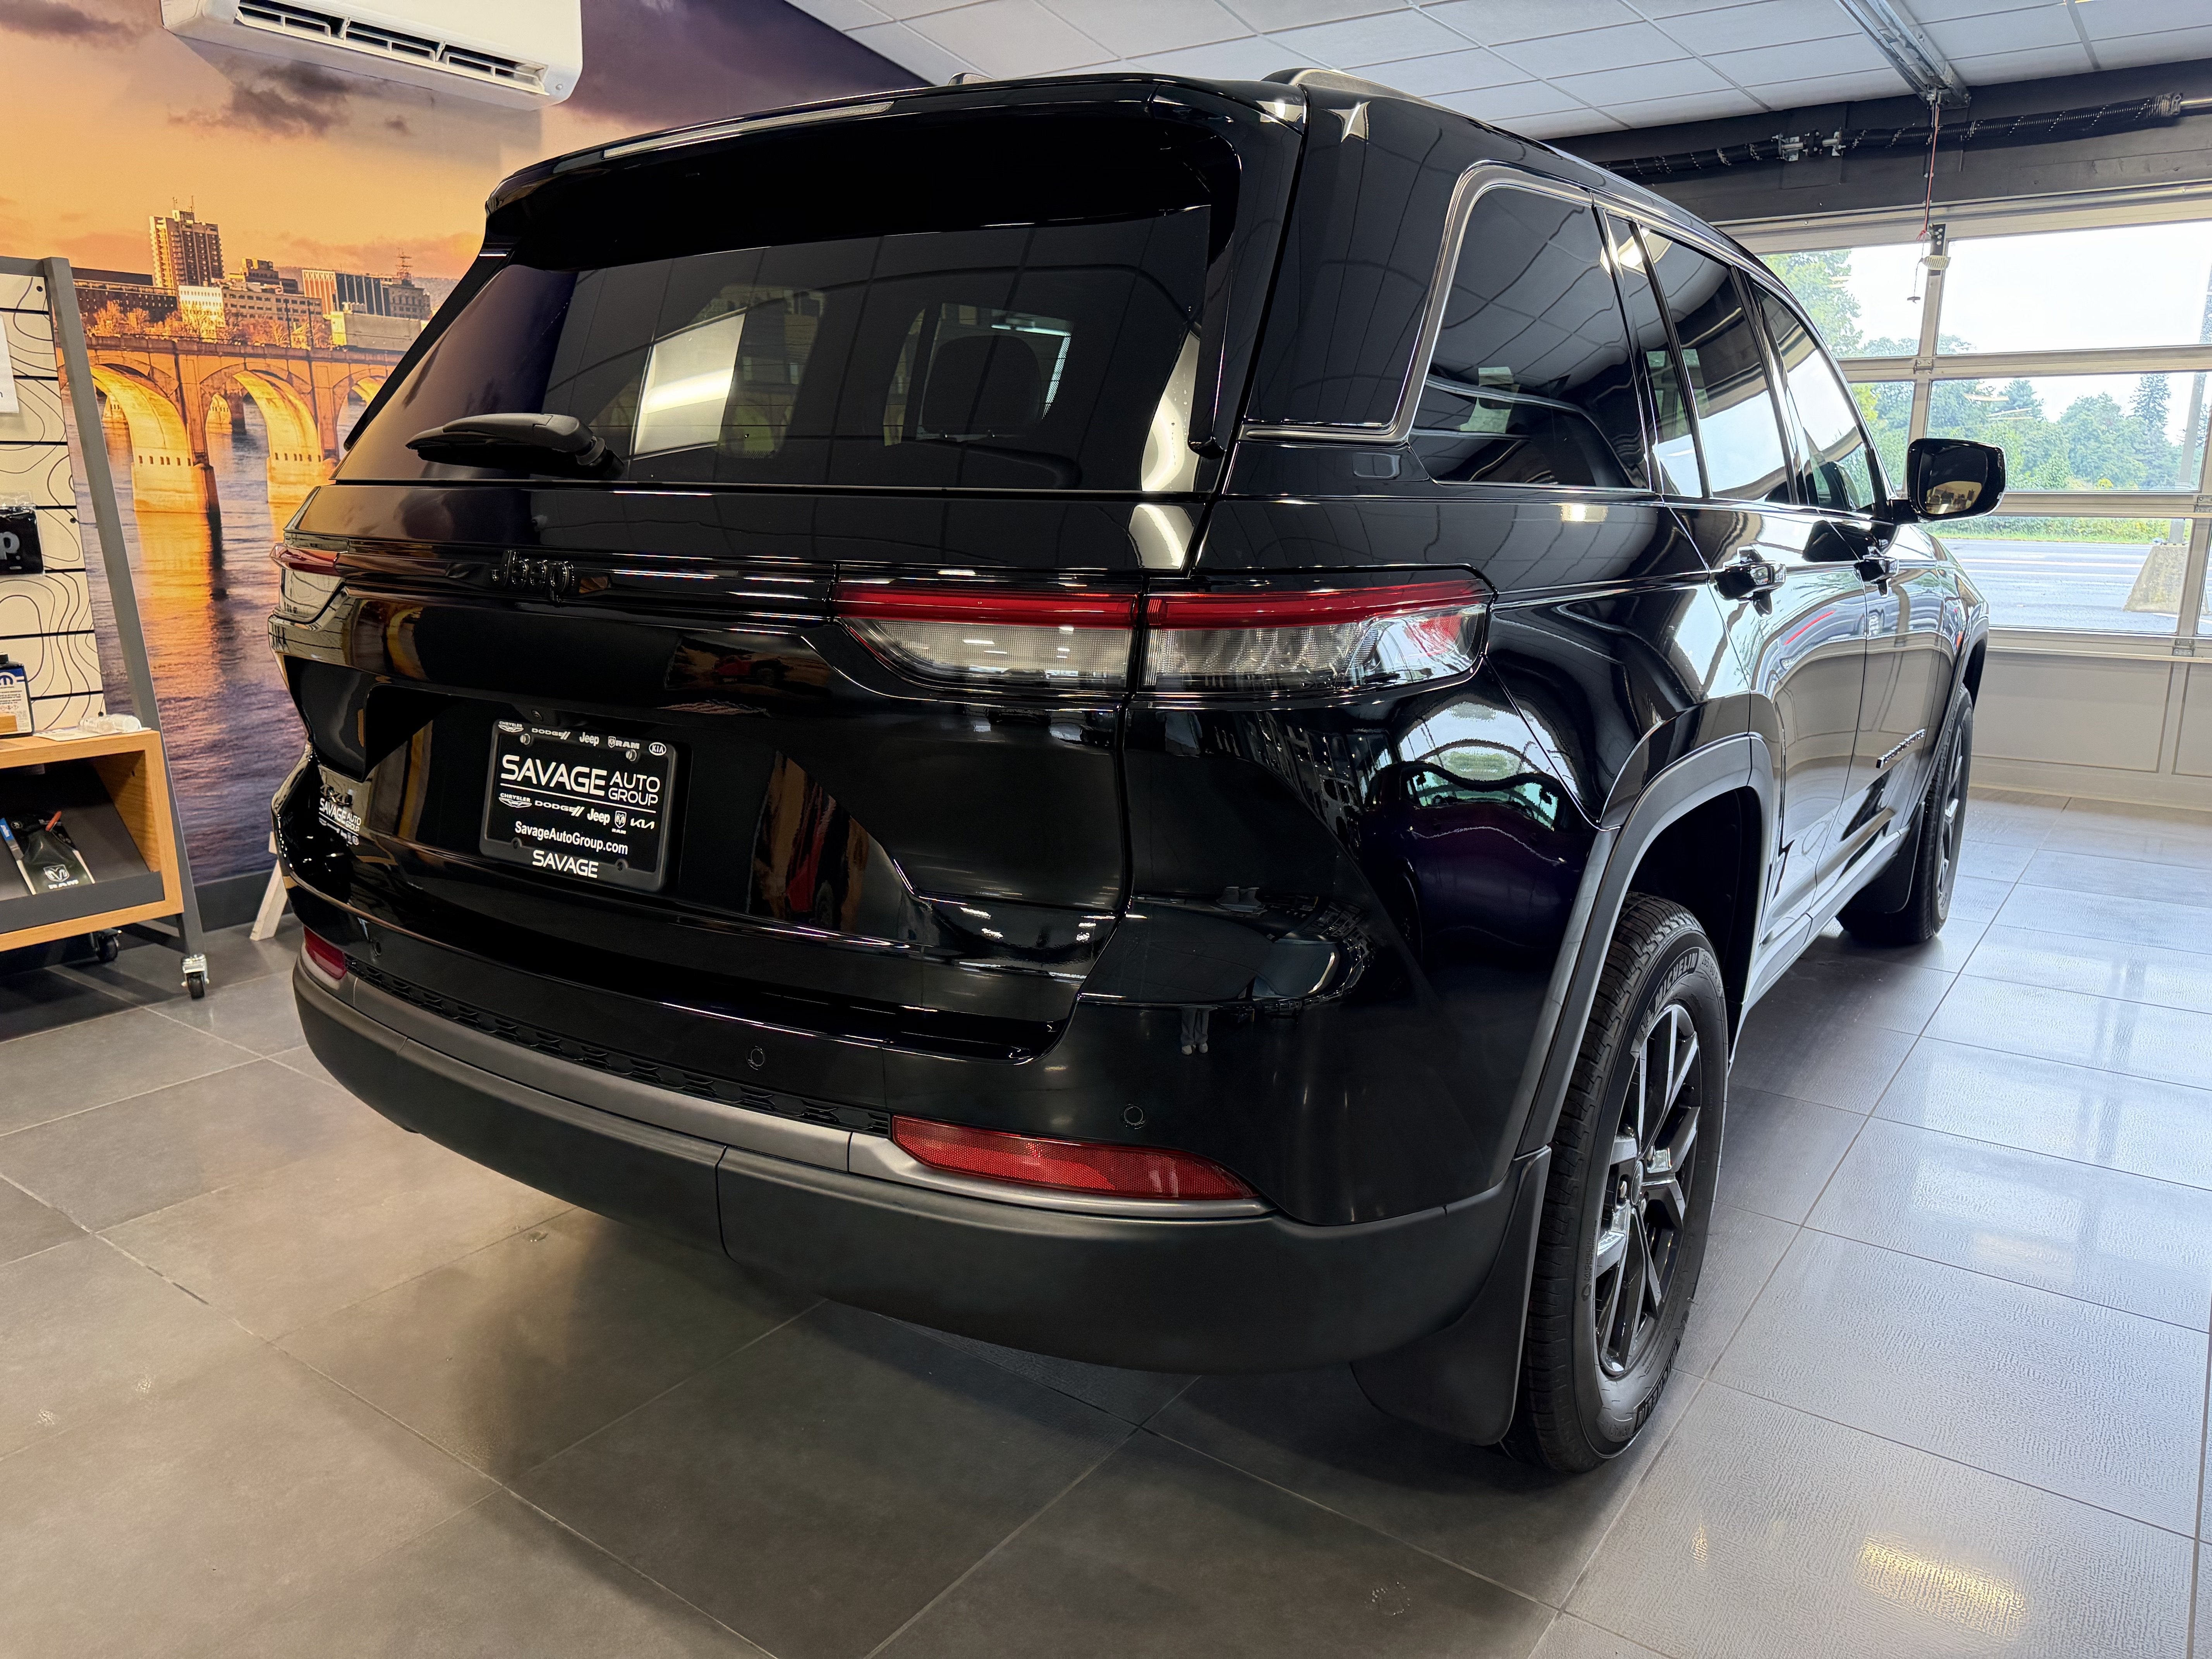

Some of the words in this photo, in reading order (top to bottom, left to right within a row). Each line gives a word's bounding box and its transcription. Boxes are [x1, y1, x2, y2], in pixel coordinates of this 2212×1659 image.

[491, 550, 574, 603] Jeep
[531, 728, 564, 737] DODGE
[579, 732, 599, 746] Jeep
[615, 740, 640, 749] RAM
[501, 754, 607, 796] SAVAGE
[610, 771, 661, 793] AUTO
[500, 793, 531, 802] CHRYSLER
[608, 787, 658, 806] GROUP
[319, 797, 347, 824] SAVAGE
[347, 813, 361, 826] AUTO
[534, 800, 576, 813] DODGE
[587, 808, 611, 826] Jeep
[630, 817, 655, 830] KIA
[345, 820, 360, 832] GROUP
[515, 821, 629, 855] SavageAutoGroup.com
[532, 849, 599, 879] SAVAGE
[48, 879, 79, 890] RAM
[1654, 952, 1698, 1013] MICHELIN
